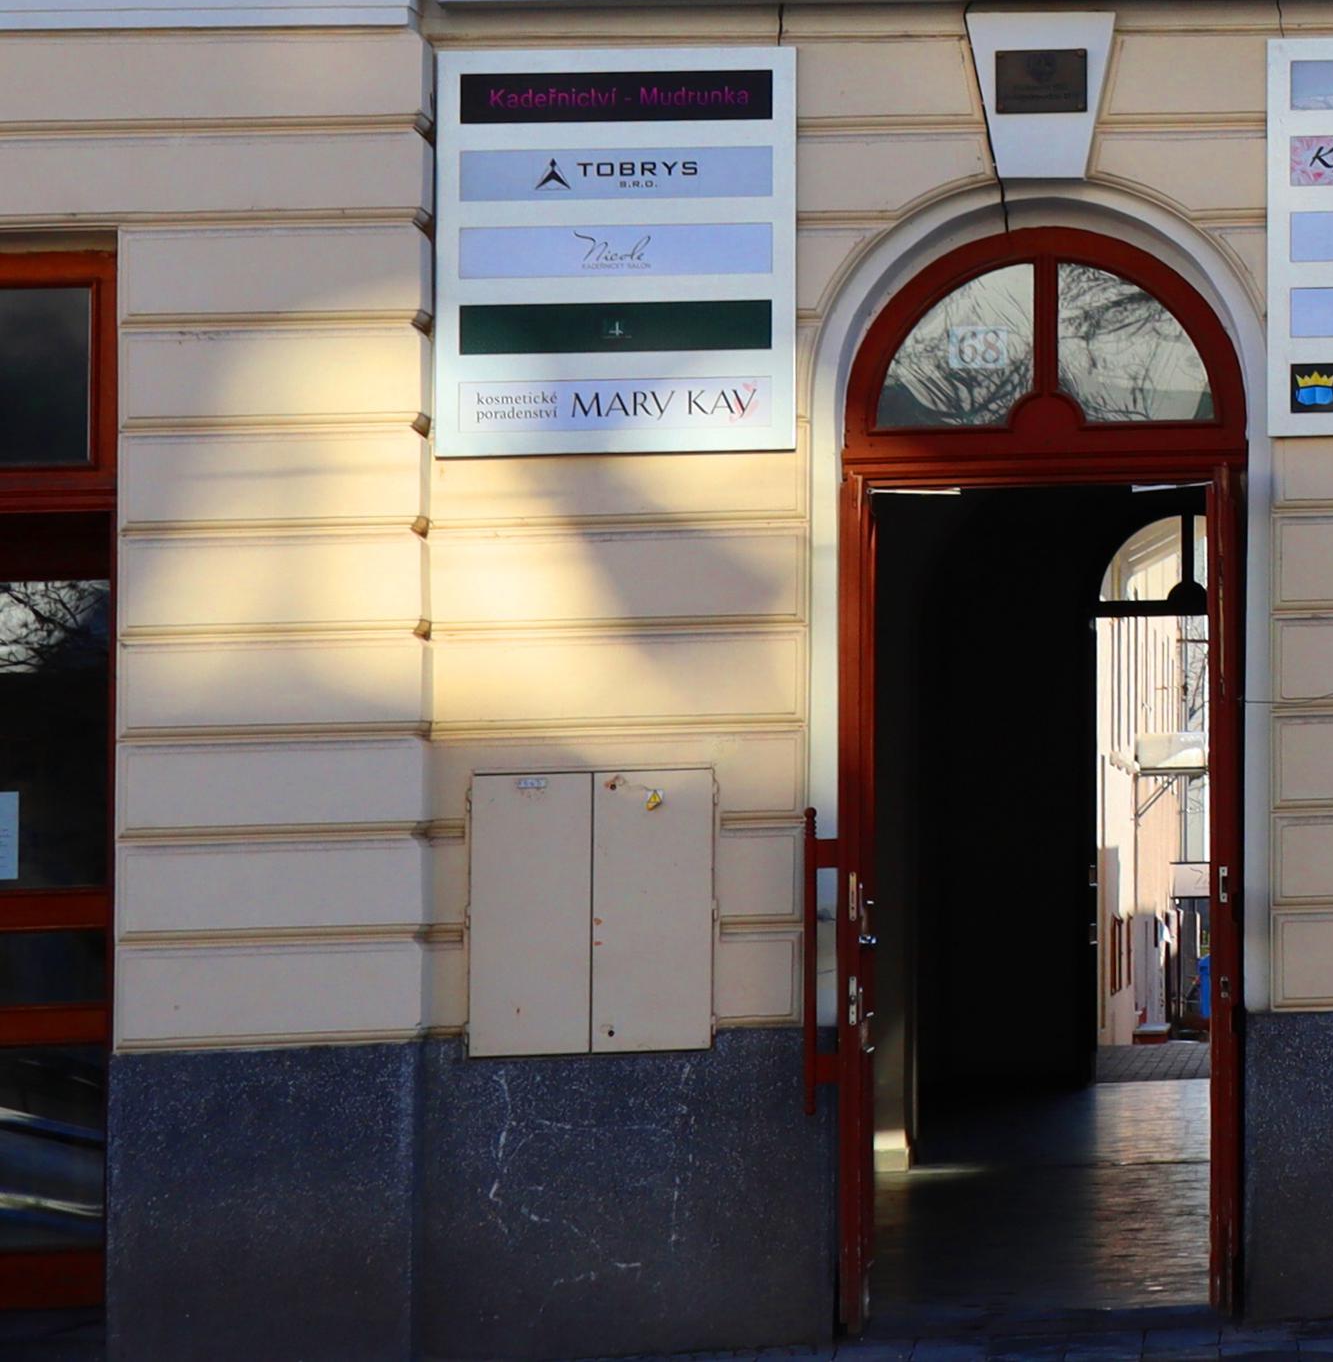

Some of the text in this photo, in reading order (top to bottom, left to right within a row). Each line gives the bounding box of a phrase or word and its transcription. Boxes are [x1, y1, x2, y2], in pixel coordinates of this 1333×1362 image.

[640, 85, 749, 107] Mudrunka
[577, 161, 698, 178] TOBRYS
[573, 230, 651, 261] Nicole
[476, 391, 558, 406] kosmetické
[571, 388, 757, 421] MARY KAY
[476, 406, 558, 422] poradenství
